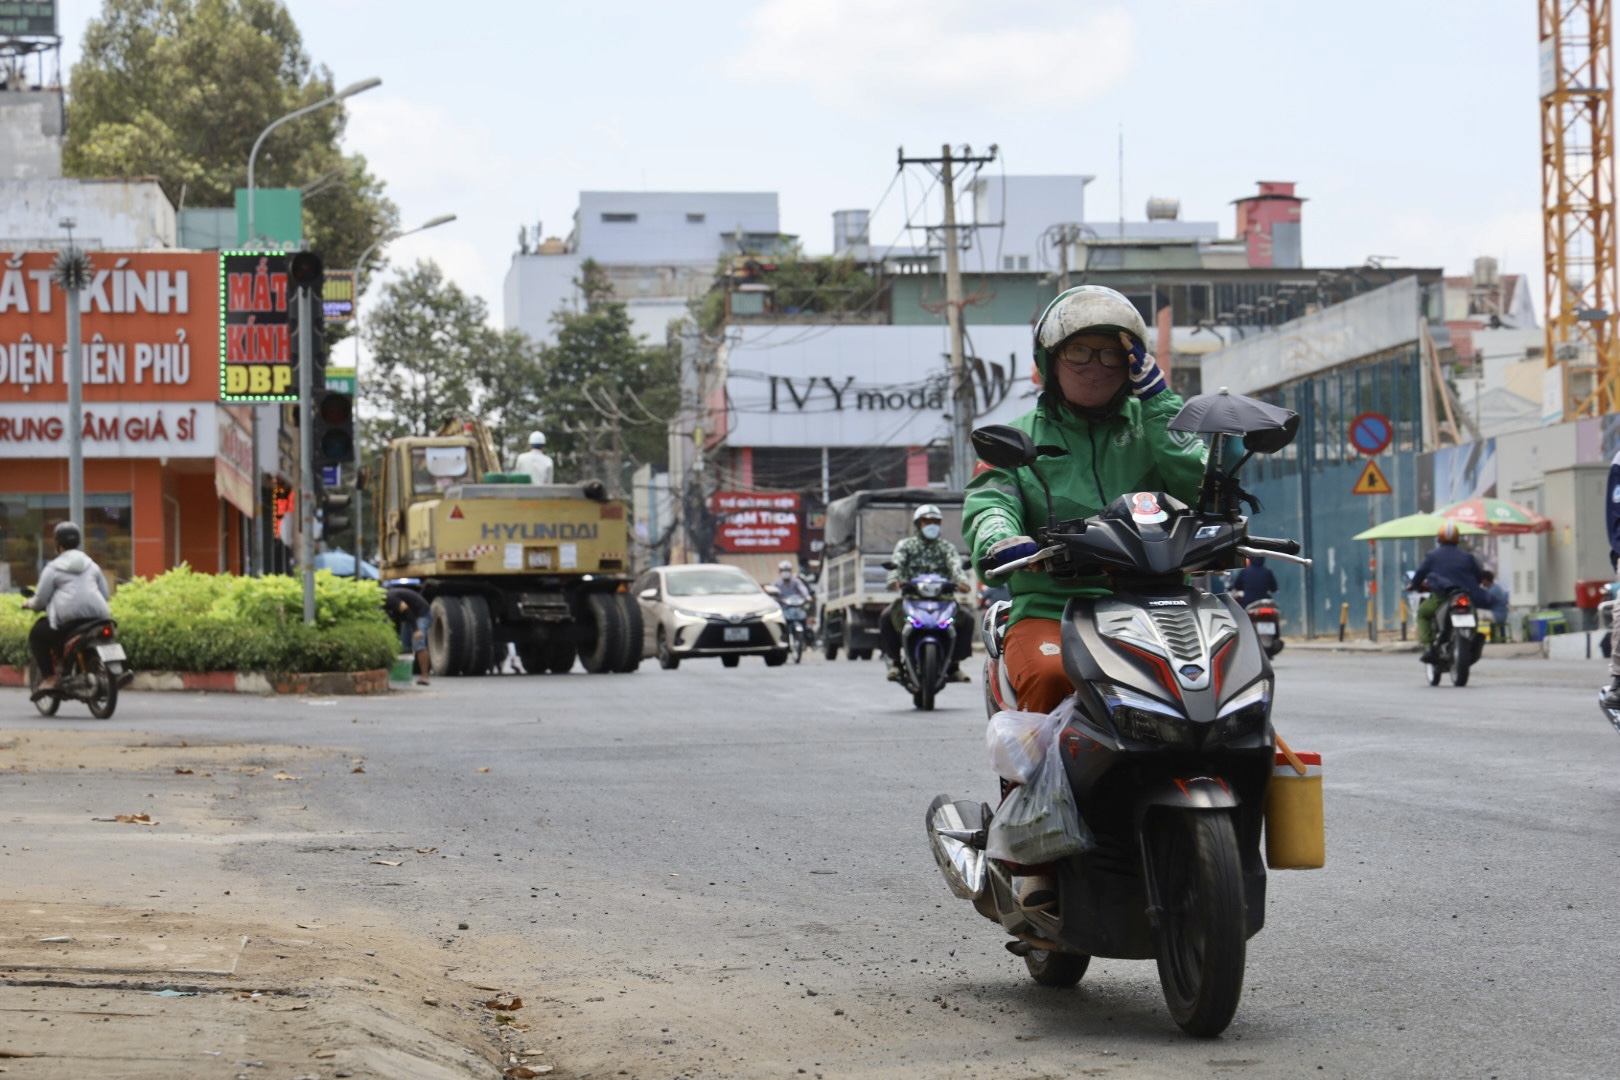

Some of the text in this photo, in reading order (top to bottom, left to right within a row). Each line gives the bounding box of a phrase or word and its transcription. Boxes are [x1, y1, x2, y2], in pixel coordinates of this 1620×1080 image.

[80, 257, 188, 313] KÍNH
[228, 257, 287, 311] MẮT
[63, 332, 125, 384] IÊN
[135, 328, 190, 384] PHỦ
[226, 315, 290, 363] KÍNH
[226, 365, 291, 394] ĐBP
[768, 375, 943, 411] IVY moda
[82, 411, 119, 441] ÂM
[481, 523, 598, 540] HYUNDAI
[1148, 599, 1188, 607] HONDA
